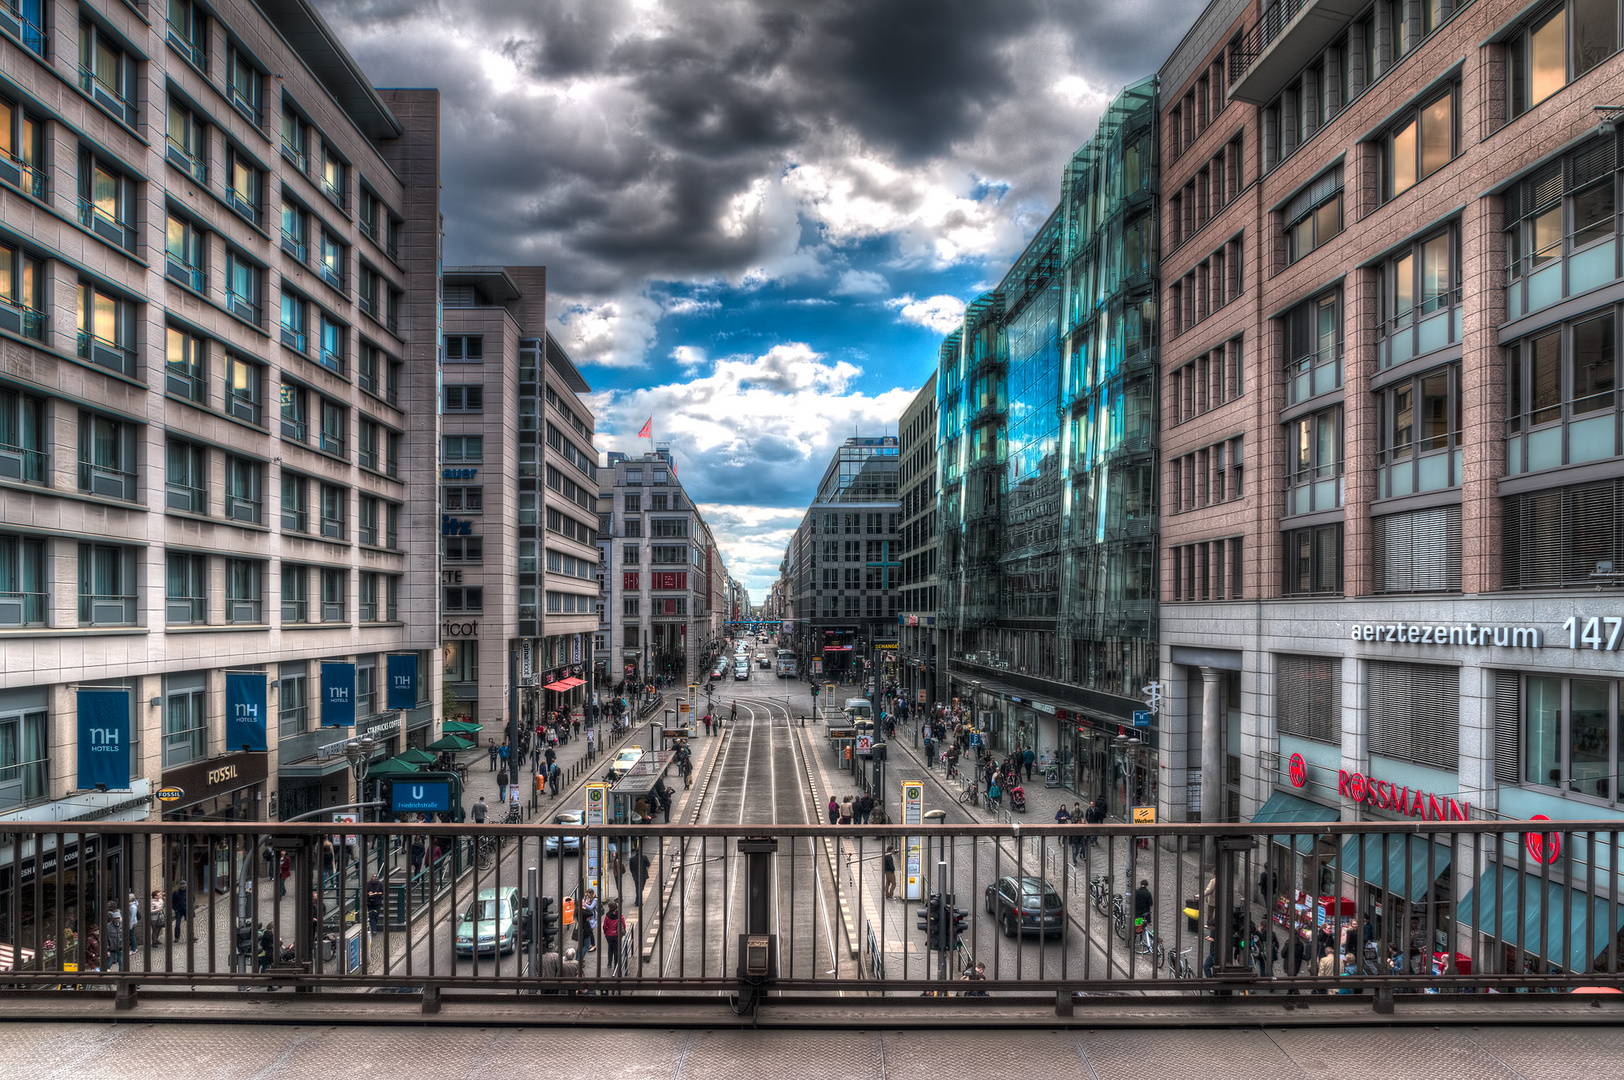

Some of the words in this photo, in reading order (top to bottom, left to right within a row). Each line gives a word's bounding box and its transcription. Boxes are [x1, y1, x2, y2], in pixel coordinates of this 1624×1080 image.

[441, 467, 477, 479] auer
[1350, 621, 1542, 648] aerztezentrum
[1562, 616, 1623, 651] 147
[366, 722, 389, 734] STARBUCKS
[388, 718, 402, 730] COFFEE
[208, 764, 238, 786] FOSSIL
[412, 786, 424, 800] U
[1338, 767, 1471, 822] ROSSMANN
[398, 801, 438, 809] Friedrichstraße
